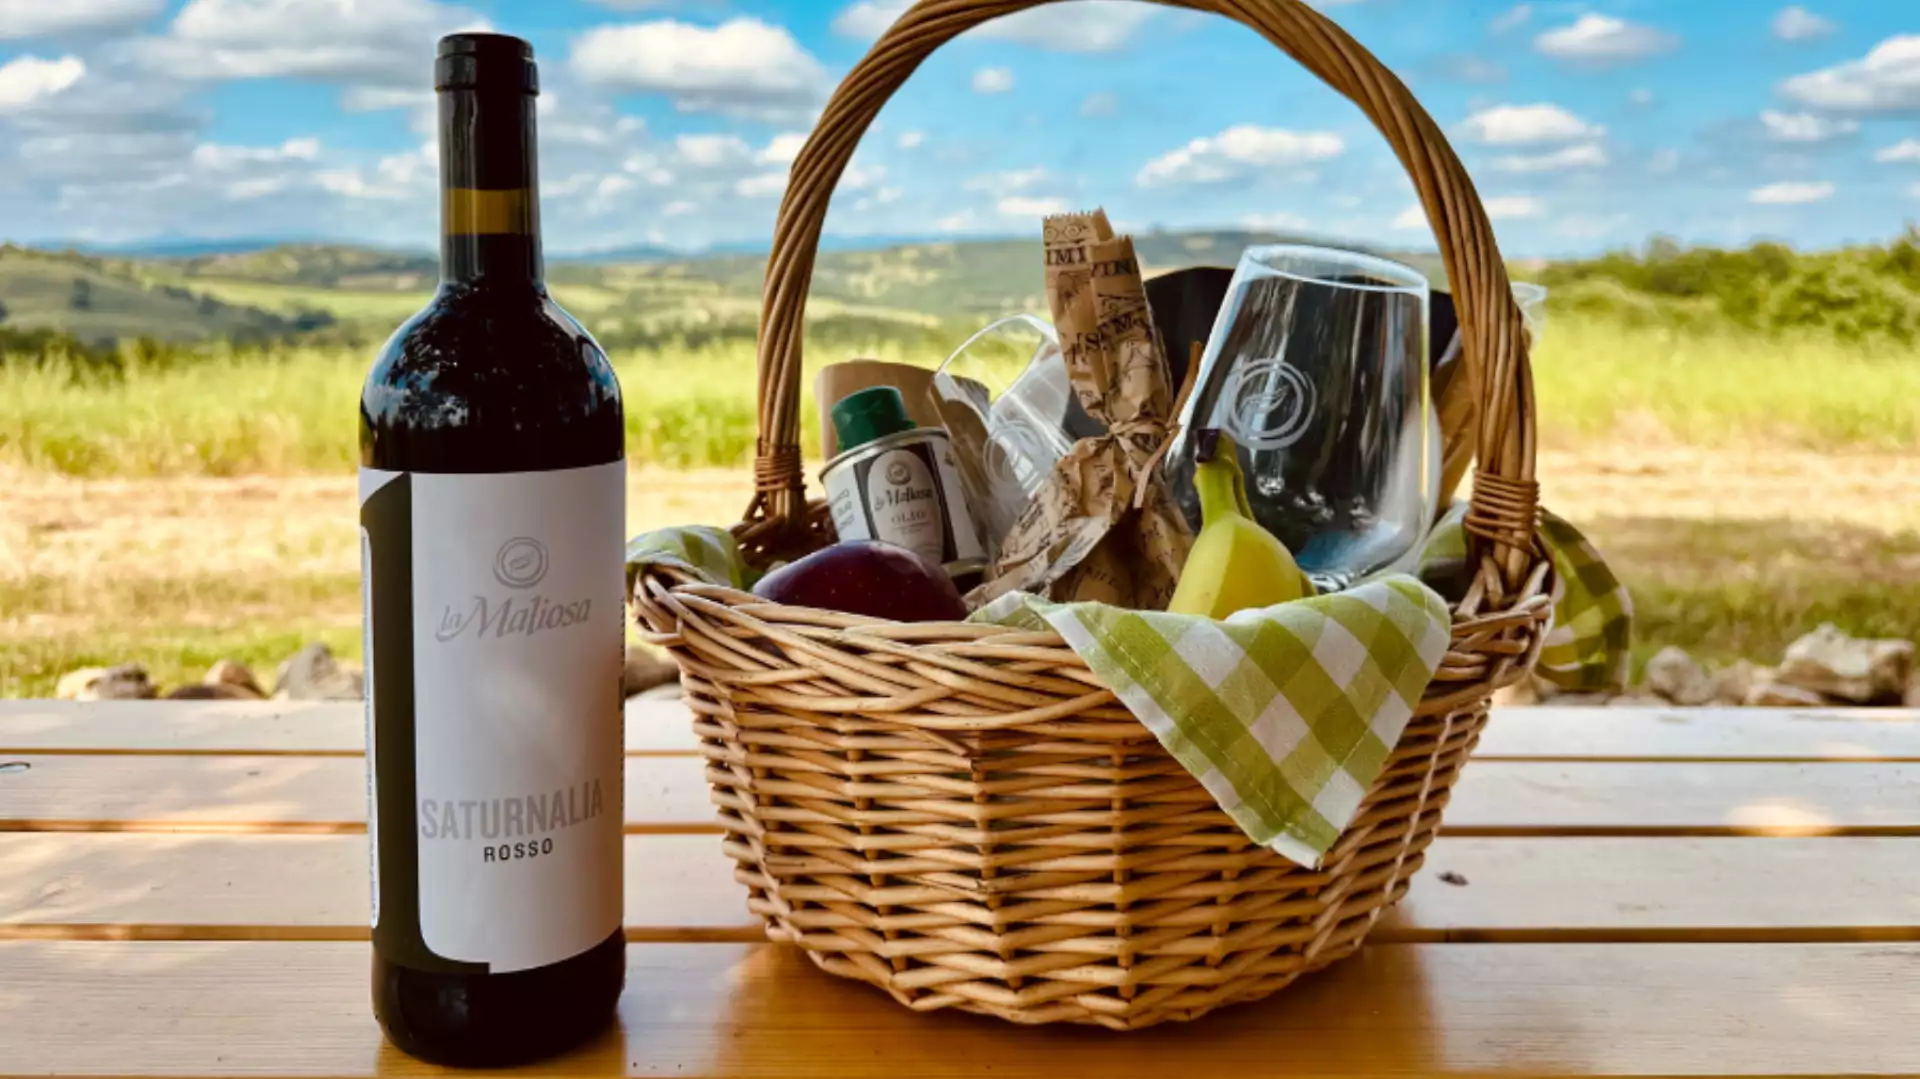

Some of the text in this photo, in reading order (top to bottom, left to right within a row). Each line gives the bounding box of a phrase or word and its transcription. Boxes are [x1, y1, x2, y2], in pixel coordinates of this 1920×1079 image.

[473, 595, 593, 639] Maliosa
[421, 778, 604, 840] SATURNALIA
[483, 837, 554, 863] ROSSO
